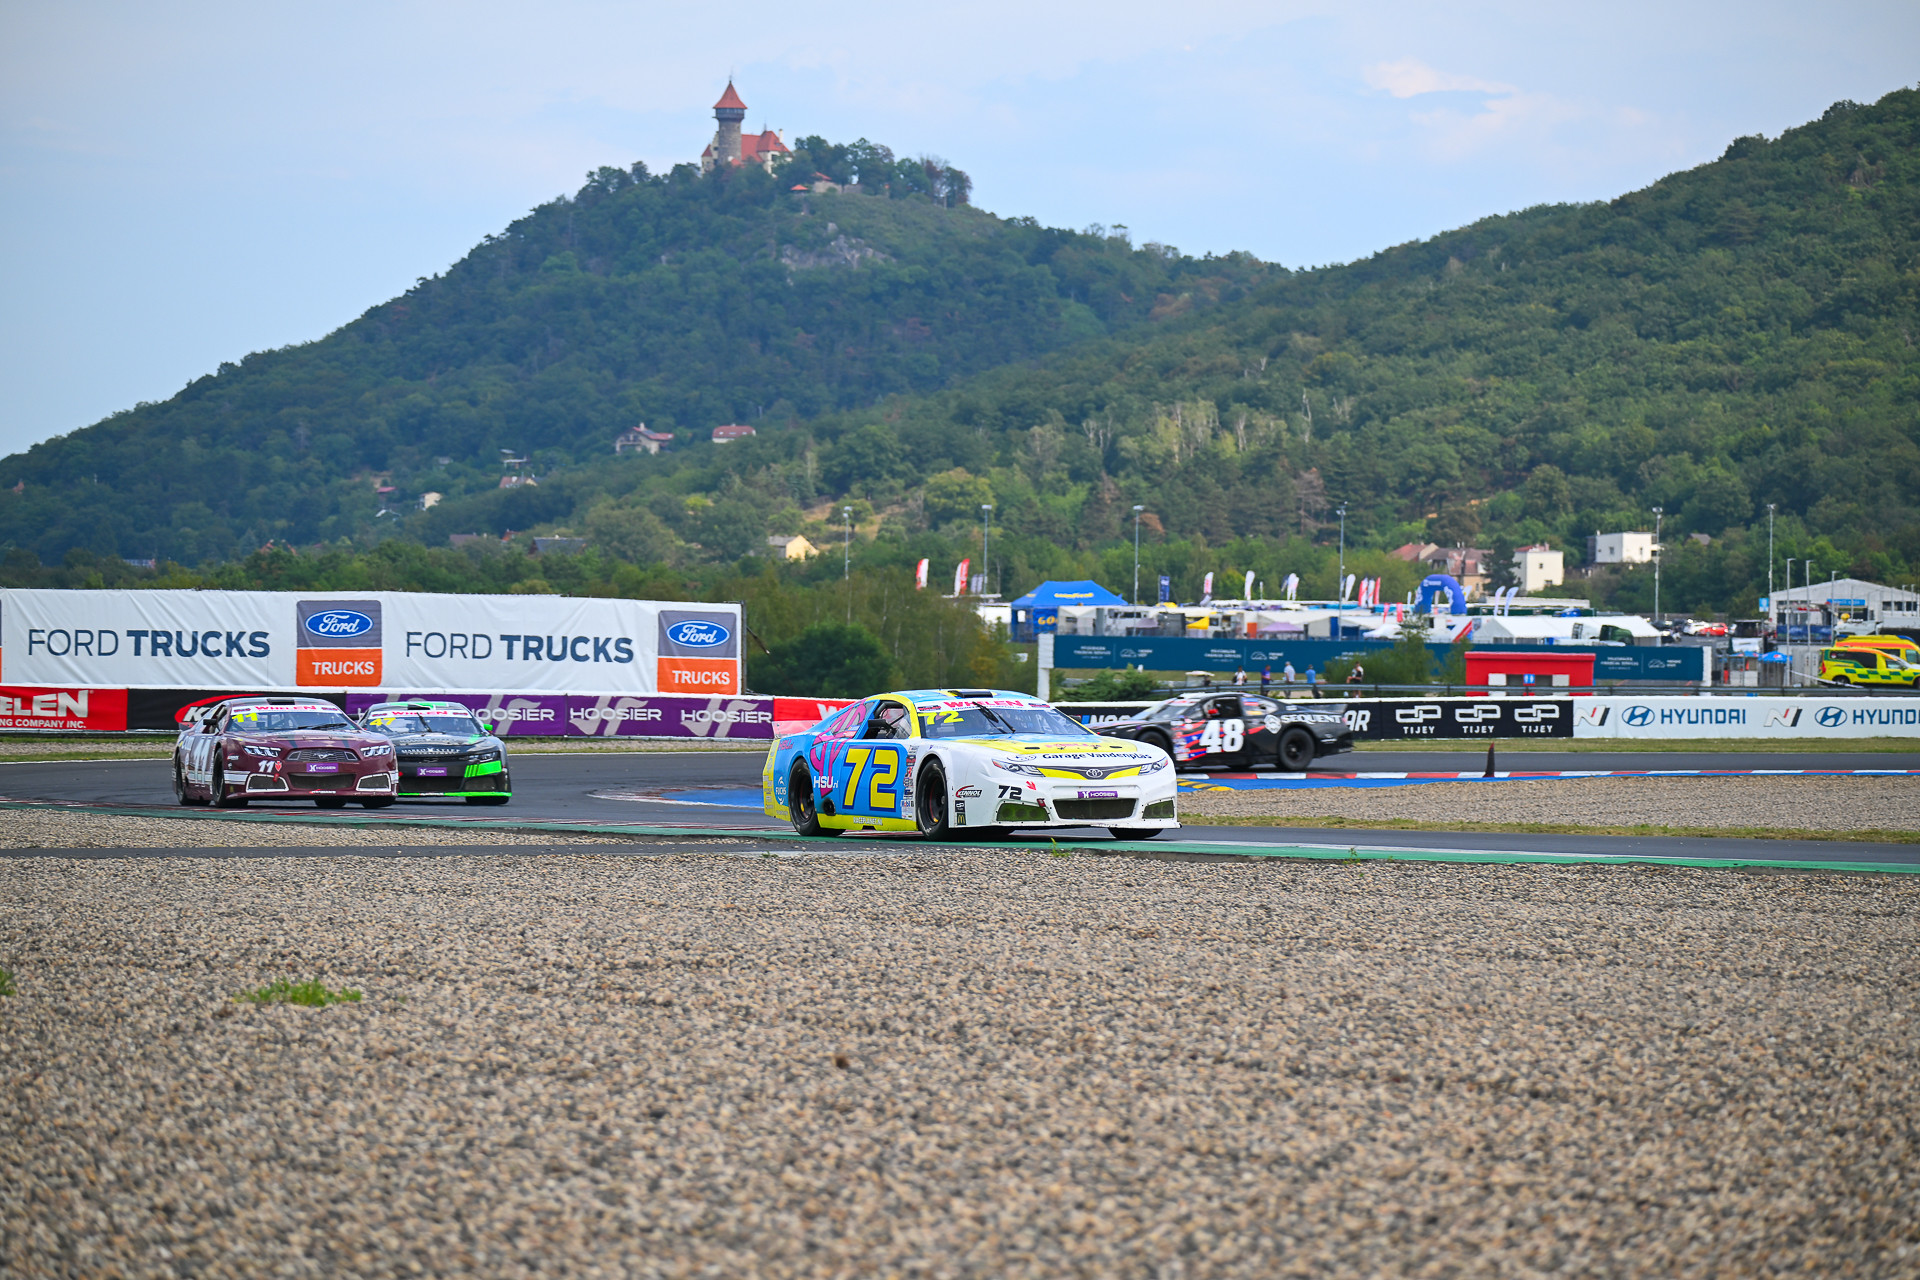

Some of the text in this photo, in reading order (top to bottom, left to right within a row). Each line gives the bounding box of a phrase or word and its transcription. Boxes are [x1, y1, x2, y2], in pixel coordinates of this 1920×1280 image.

[319, 613, 360, 633] Ford
[678, 624, 717, 644] Ford
[28, 628, 270, 658] FORD TRUCKS
[406, 631, 635, 664] FORD TRUCKS
[312, 661, 375, 675] TRUCKS
[672, 670, 731, 685] TRUCKS
[232, 712, 258, 723] 11
[369, 717, 396, 726] 47
[470, 708, 555, 721] OOSIER
[569, 707, 662, 722] HOOSIER
[681, 709, 773, 724] HOOSIER
[918, 710, 965, 725] 72
[1280, 714, 1342, 725] SEQUENT
[1661, 708, 1746, 724] HYUNDAI
[15, 718, 64, 728] COMPANY
[66, 720, 87, 729] INC.
[1403, 725, 1436, 734] TIJEY
[1462, 725, 1495, 734] TIJEY
[1521, 725, 1553, 734] TIJEY
[1199, 718, 1245, 753] 48
[1042, 752, 1087, 760] Garage
[258, 760, 275, 773] 11
[841, 745, 900, 812] 72
[997, 785, 1023, 800] 72
